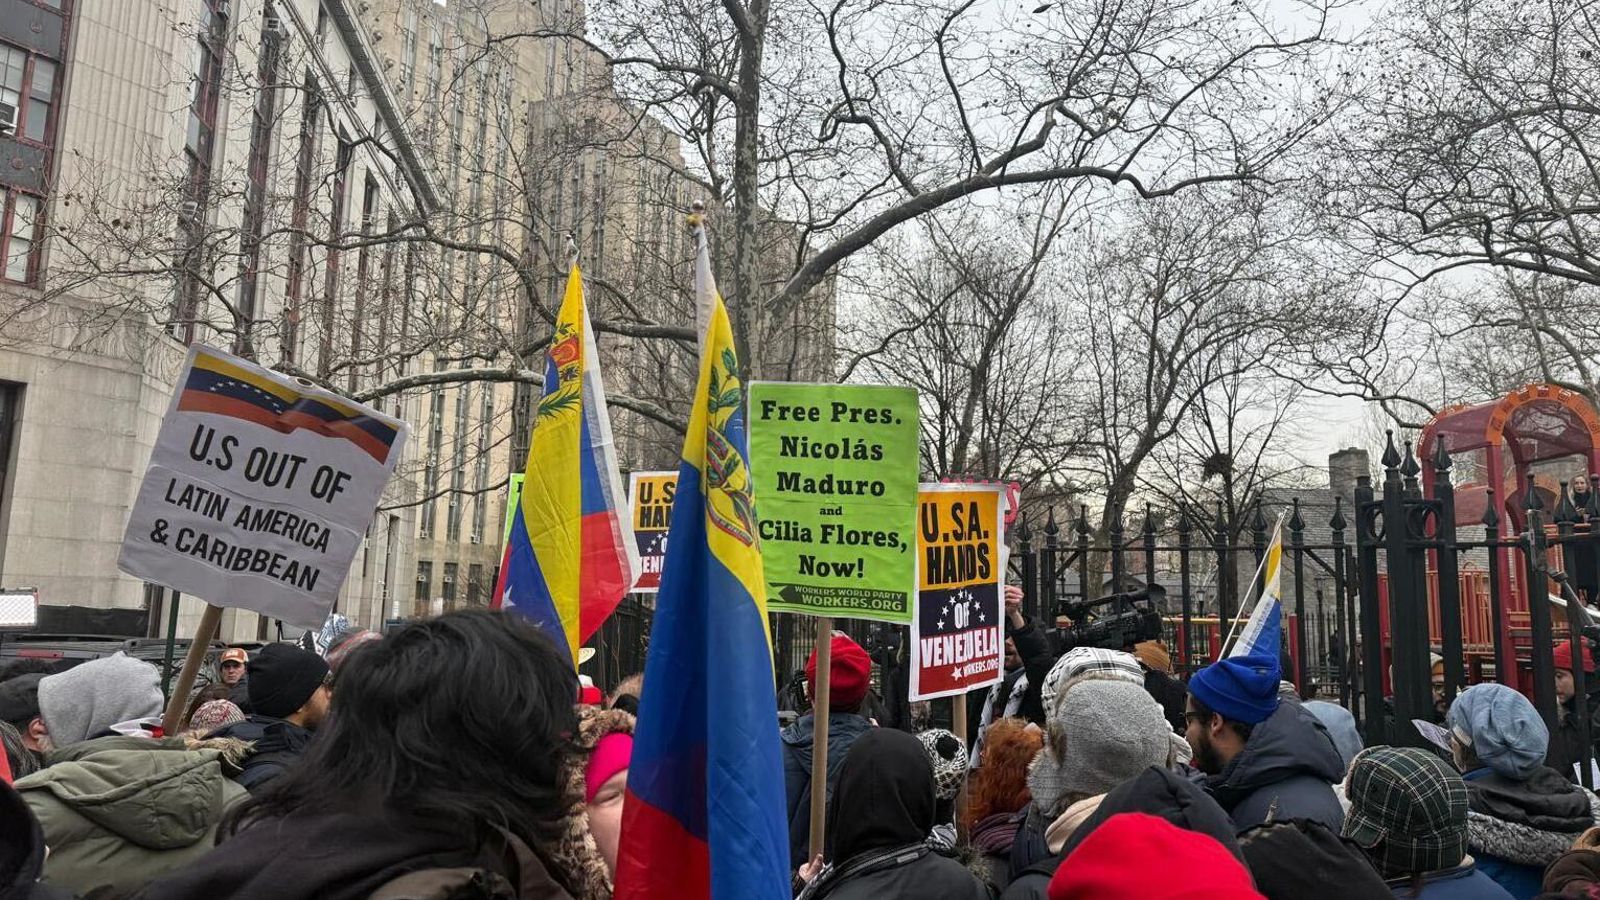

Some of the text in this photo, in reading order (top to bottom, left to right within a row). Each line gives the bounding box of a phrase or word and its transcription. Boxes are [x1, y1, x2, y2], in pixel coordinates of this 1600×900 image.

[761, 400, 902, 425] Free Pres.
[780, 436, 883, 460] Nicolás
[190, 424, 352, 504] U.S OUT OF
[777, 471, 885, 496] Maduro
[165, 478, 331, 553] LATIN AMERICA
[820, 506, 842, 516] and
[922, 502, 989, 542] U.S.A.
[759, 520, 812, 543] Cilia
[820, 524, 907, 553] Flores,
[150, 519, 320, 591] & CARIBBEAN
[799, 555, 863, 577] Now!
[927, 543, 990, 585] HANDS
[795, 586, 835, 595] WORKERS
[838, 589, 871, 597] WORLD
[802, 595, 902, 611] WORKERS.ORG
[921, 628, 998, 668] VENEZUELA
